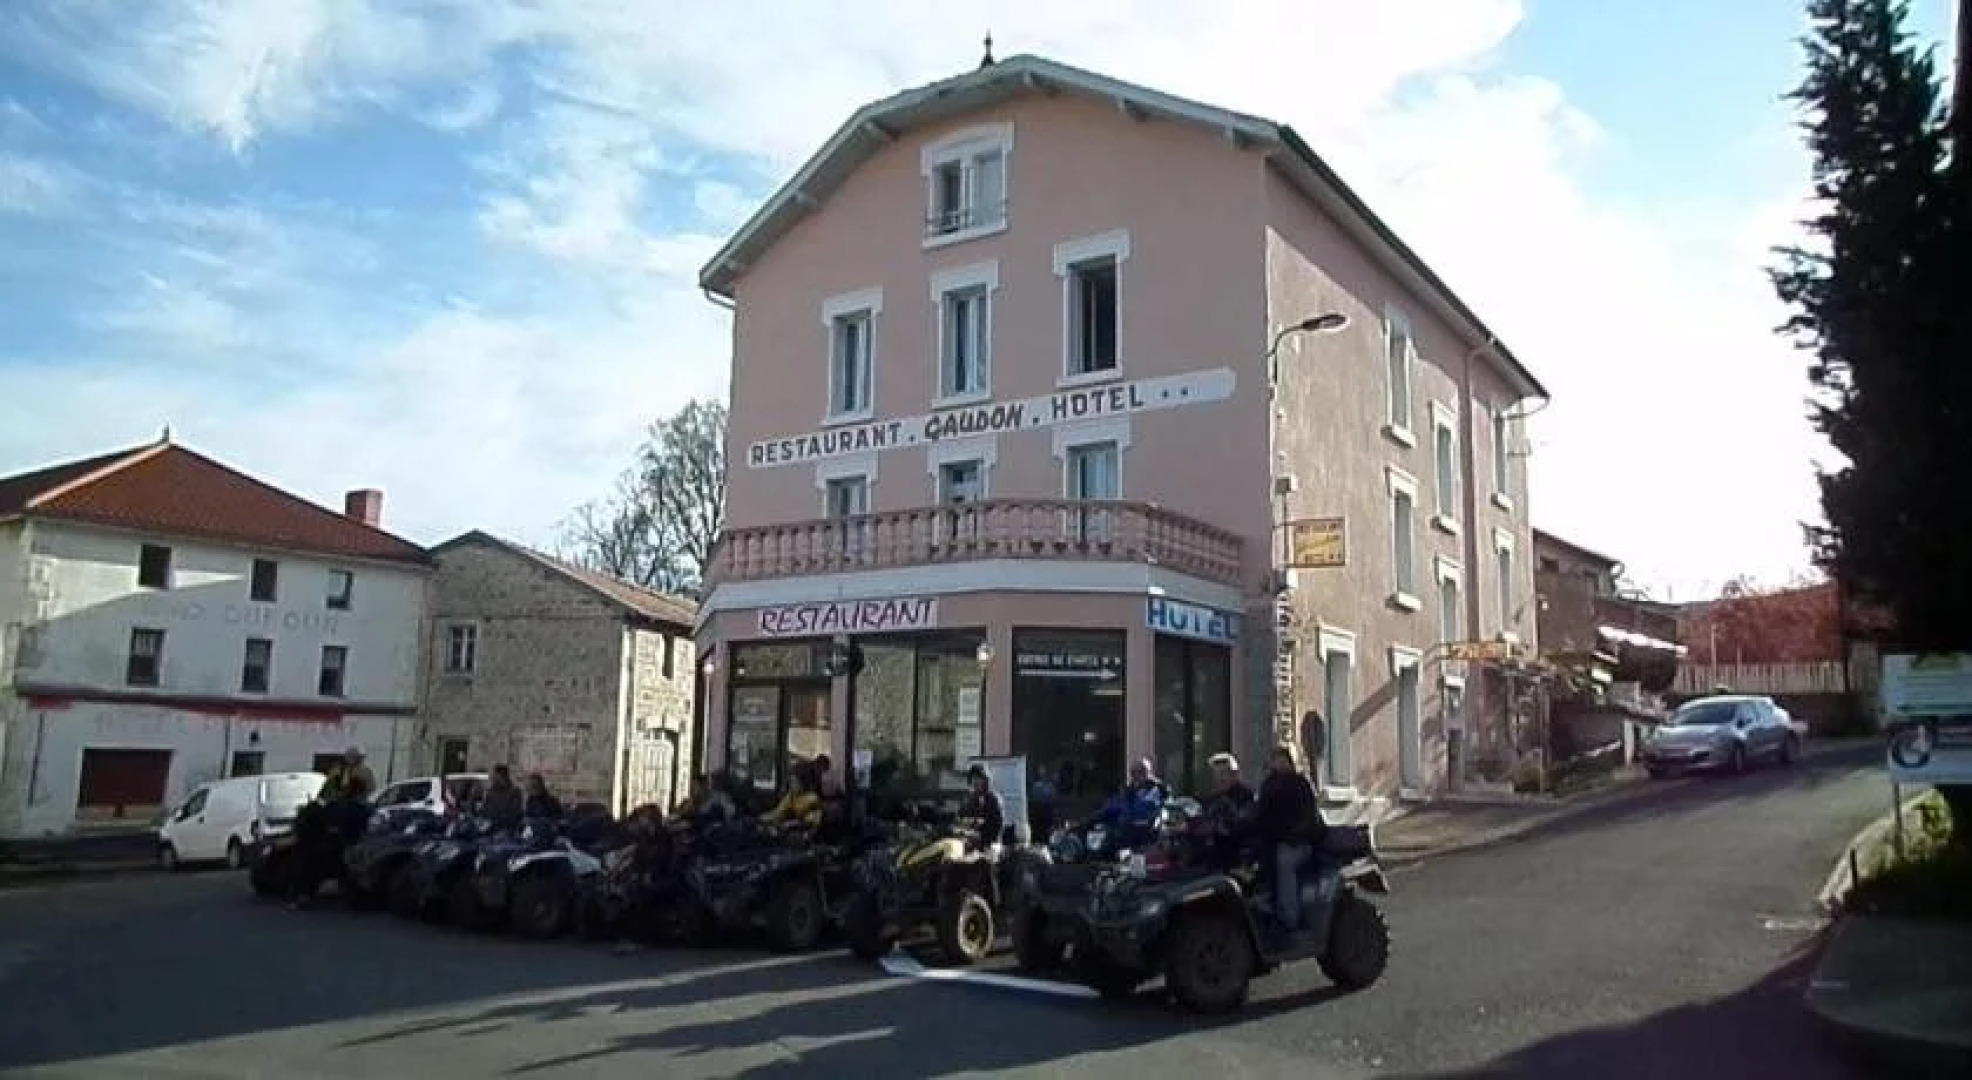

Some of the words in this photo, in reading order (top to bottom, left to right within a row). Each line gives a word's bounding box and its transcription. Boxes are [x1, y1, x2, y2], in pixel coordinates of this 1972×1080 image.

[753, 423, 902, 466] RESTAURANT
[925, 403, 1025, 441] GAUDON
[1051, 384, 1143, 419] HOTEL
[762, 600, 938, 634] RESTAURANT
[1147, 596, 1239, 638] HOTEL
